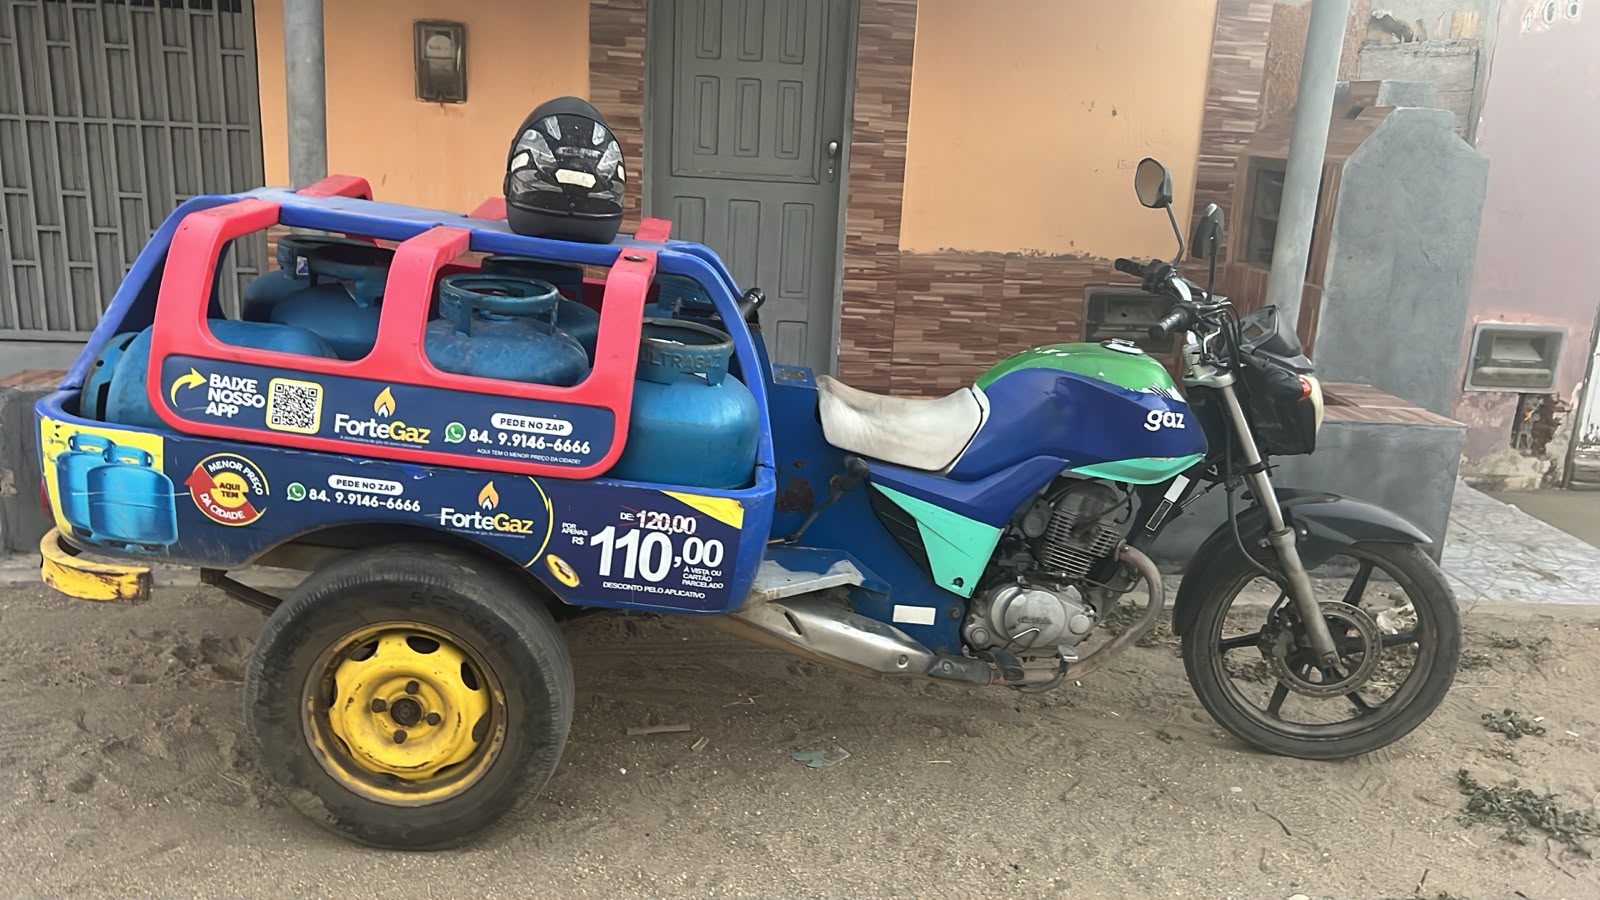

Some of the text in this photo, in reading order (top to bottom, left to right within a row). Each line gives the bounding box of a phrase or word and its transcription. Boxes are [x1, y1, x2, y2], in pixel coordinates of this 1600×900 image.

[209, 373, 258, 393] BAIXE
[208, 387, 265, 408] NOSSO
[205, 401, 239, 418] APP
[334, 413, 431, 444] ForteGaz
[500, 417, 565, 432] PEDE NO ZAP
[1143, 410, 1185, 432] gaz
[468, 428, 591, 454] 84. 9.9146-6666
[530, 454, 550, 462] PREÇO
[208, 460, 263, 496] MENOR PREÇO
[219, 482, 240, 491] AQUI
[336, 478, 360, 488] PEDE
[378, 484, 396, 492] ZAP
[221, 490, 239, 498] TEM
[308, 488, 420, 512] 84. 9.9146-6666
[200, 493, 246, 520] DA CIDADE
[440, 508, 534, 534] ForteGaz
[562, 522, 577, 530] POR
[636, 510, 697, 535] 120,00
[561, 528, 588, 536] APENAS
[590, 525, 724, 582] 110,00
[682, 572, 713, 582] CARTÃO
[690, 568, 710, 576] VISTA
[602, 582, 706, 599] DESCONTO PELO APLICATIVO
[682, 580, 724, 589] PARCELADO
